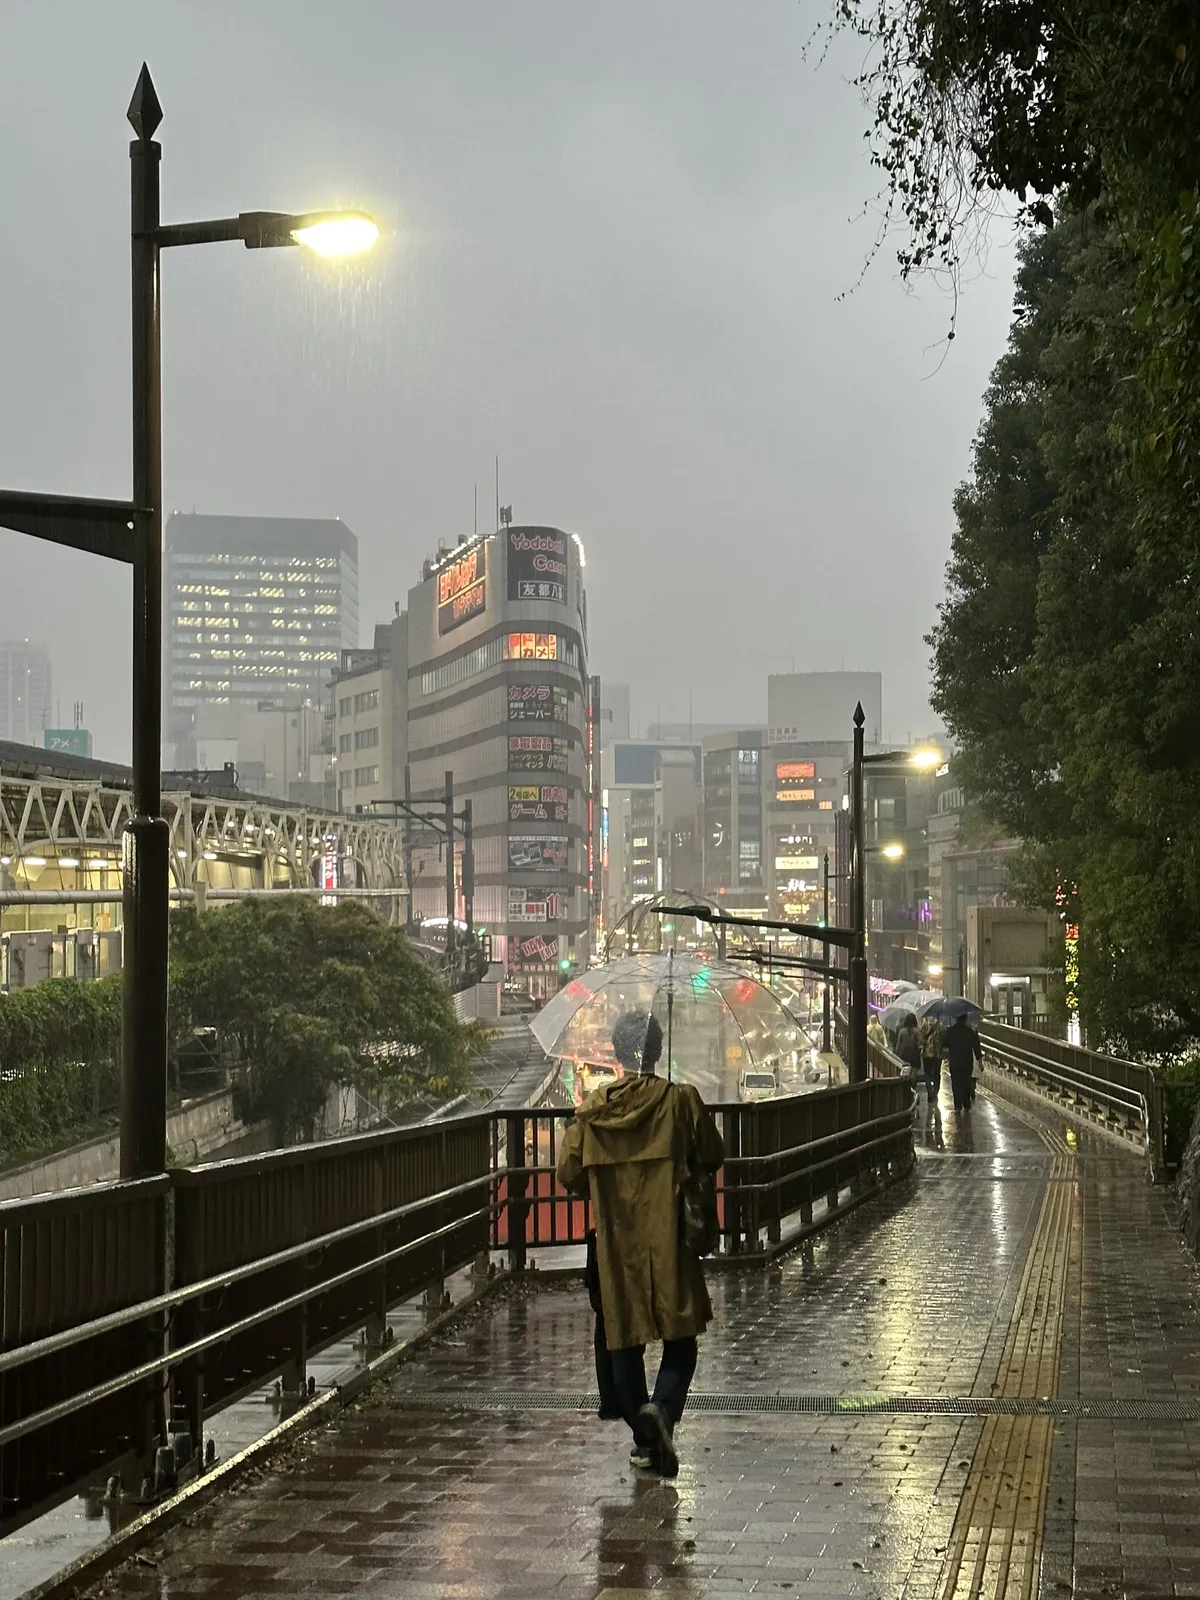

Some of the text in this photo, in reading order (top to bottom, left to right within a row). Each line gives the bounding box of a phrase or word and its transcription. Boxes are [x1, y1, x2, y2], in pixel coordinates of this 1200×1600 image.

[508, 685, 550, 700] カメラ
[510, 710, 551, 719] シェーバー
[511, 804, 548, 819] ゲーム
